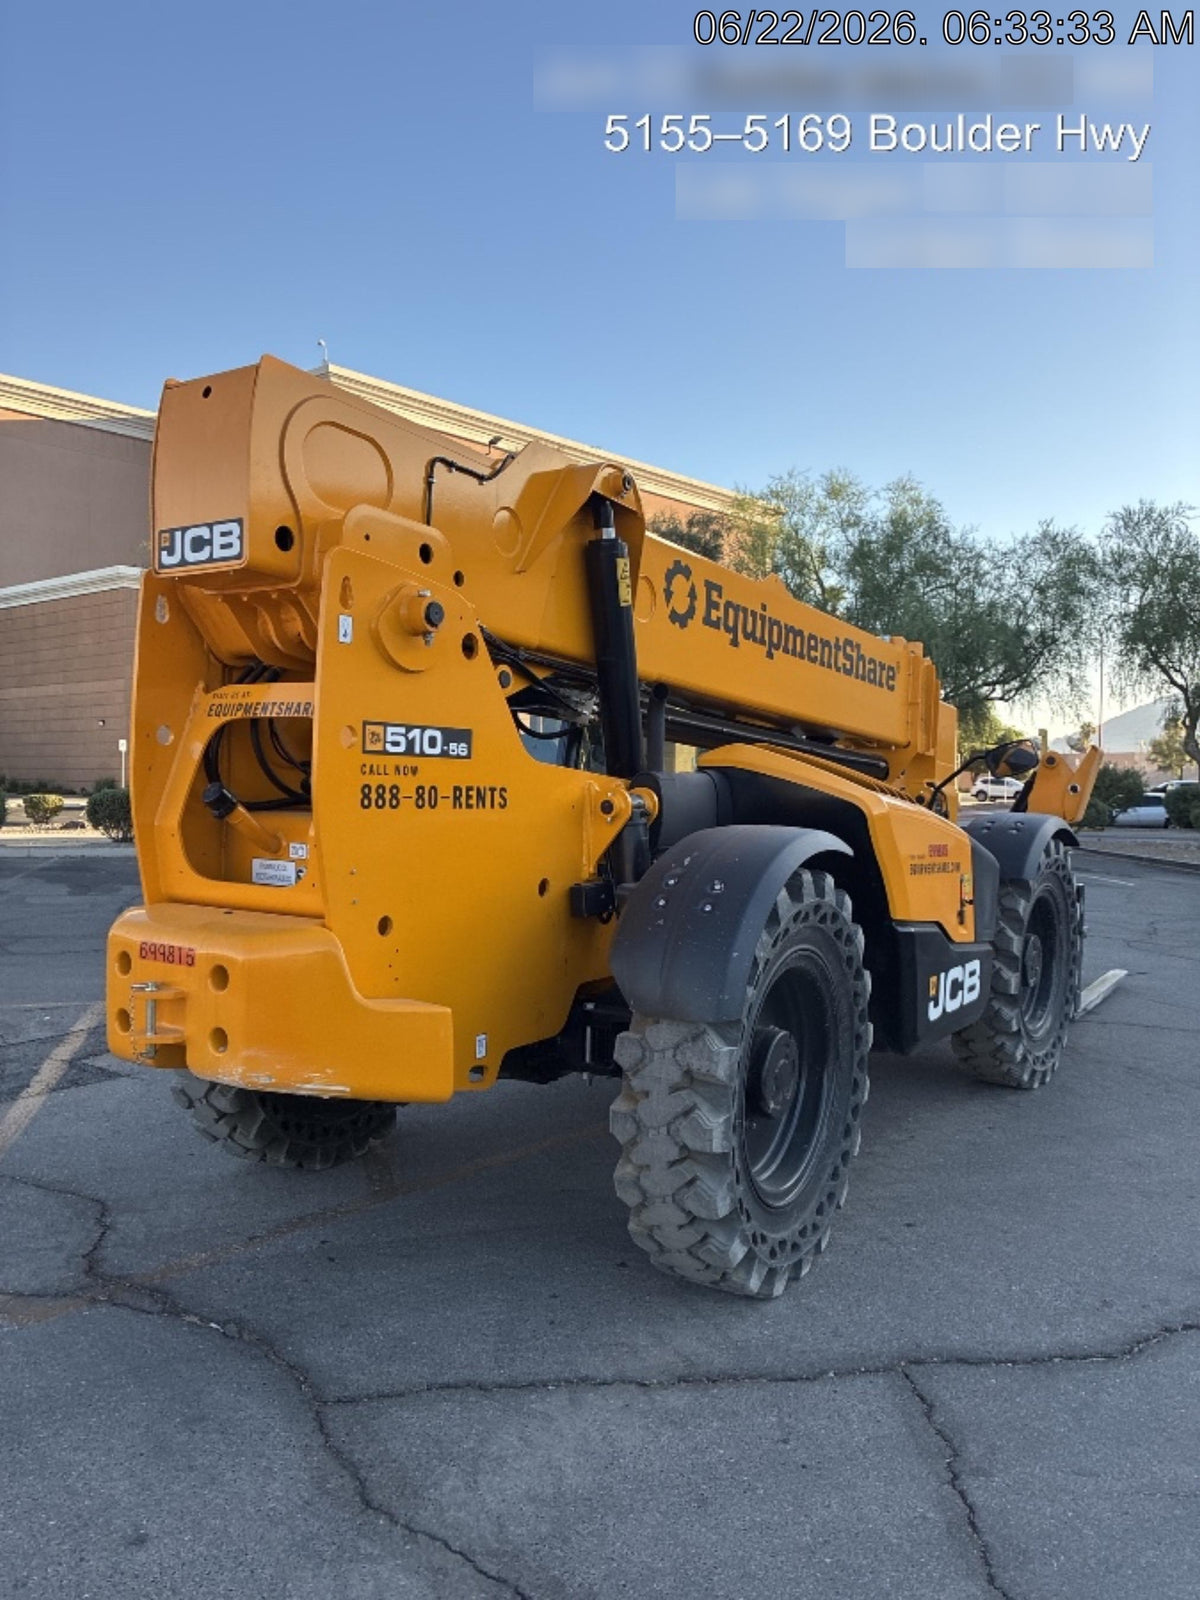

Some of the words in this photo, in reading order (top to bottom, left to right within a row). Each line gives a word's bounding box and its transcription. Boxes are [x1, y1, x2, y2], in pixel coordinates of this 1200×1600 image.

[161, 522, 240, 566] JCB
[702, 579, 897, 692] EquipmentShare
[361, 764, 389, 776] CALL
[394, 765, 419, 776] NOW
[360, 783, 508, 810] 888-80-RENTS
[140, 941, 194, 967] 699815
[928, 958, 980, 1021] JCB
